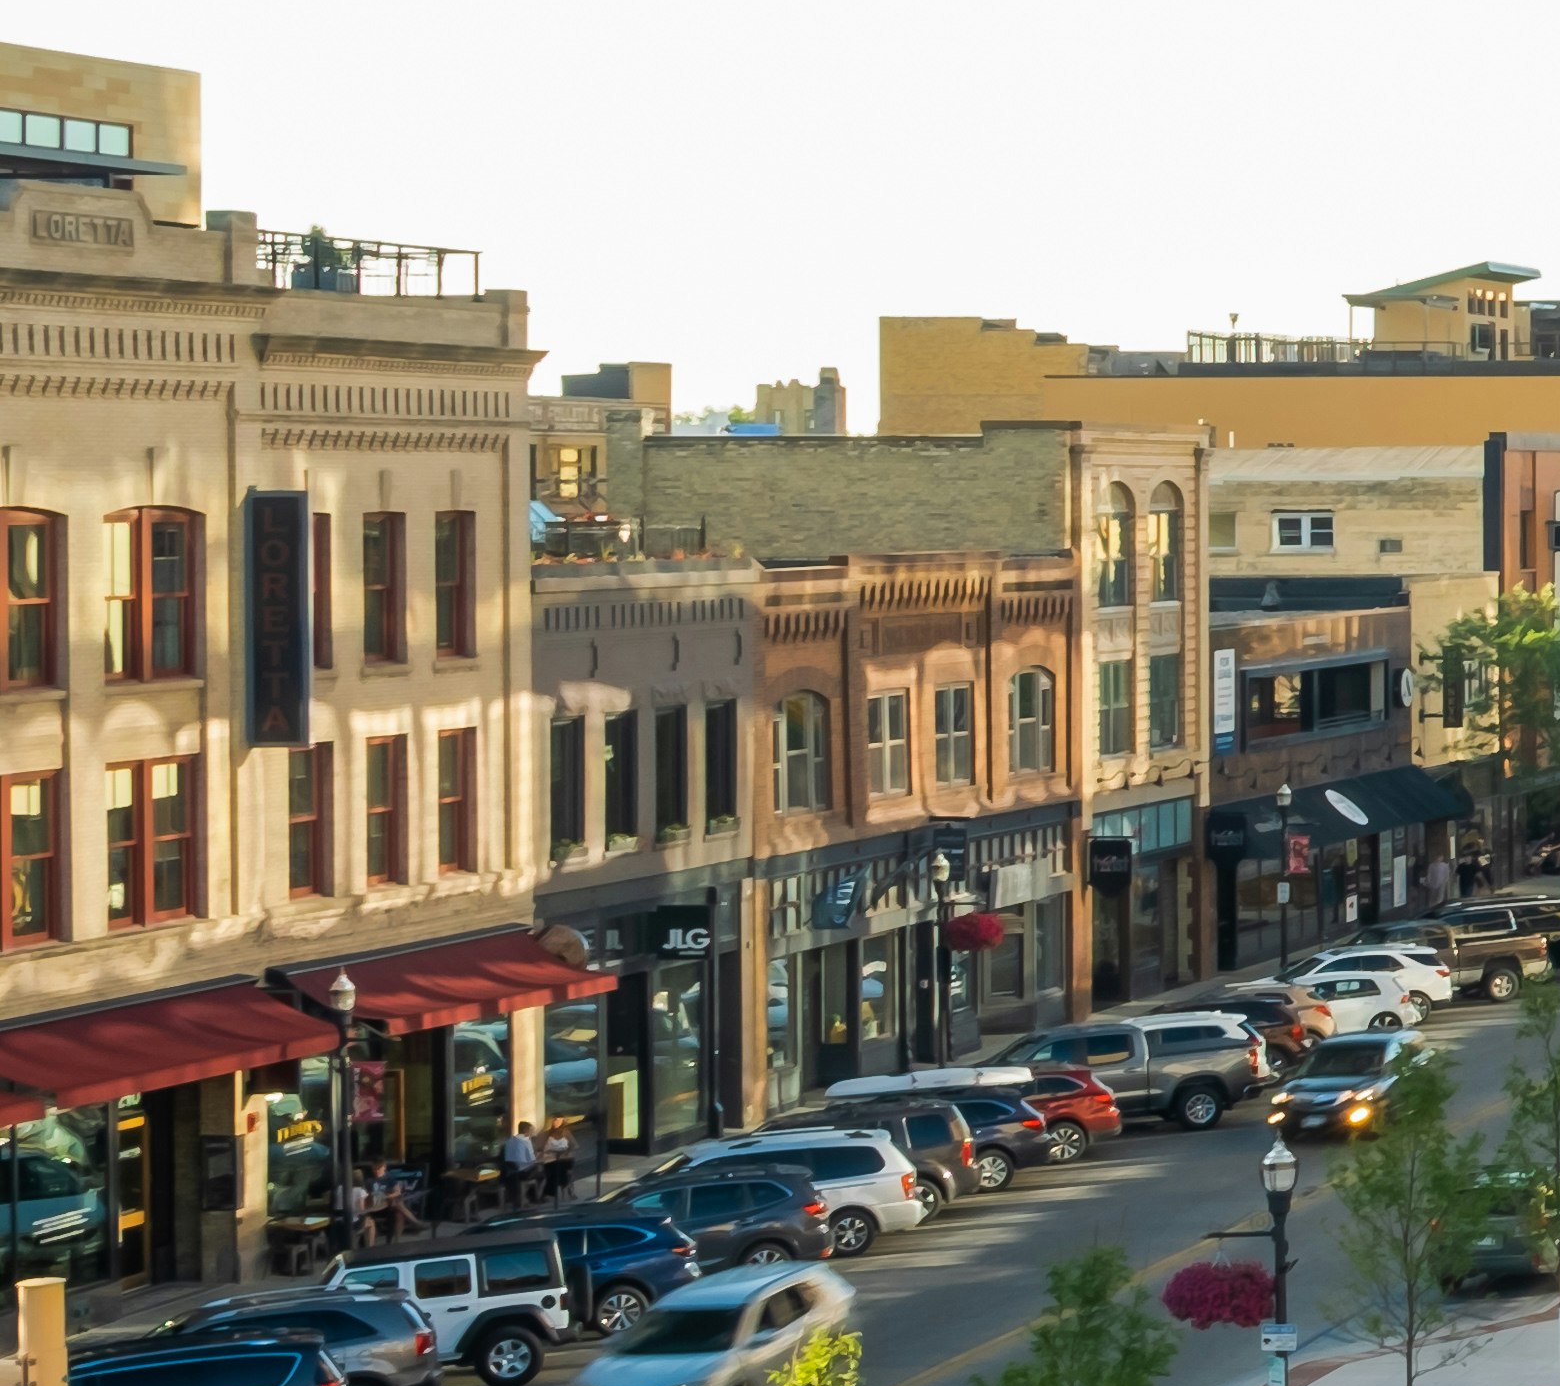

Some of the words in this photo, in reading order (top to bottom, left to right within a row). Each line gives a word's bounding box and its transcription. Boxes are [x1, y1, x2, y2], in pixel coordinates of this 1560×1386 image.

[33, 213, 132, 247] LORETTA
[261, 506, 289, 731] LORETTA
[662, 928, 711, 949] JLG
